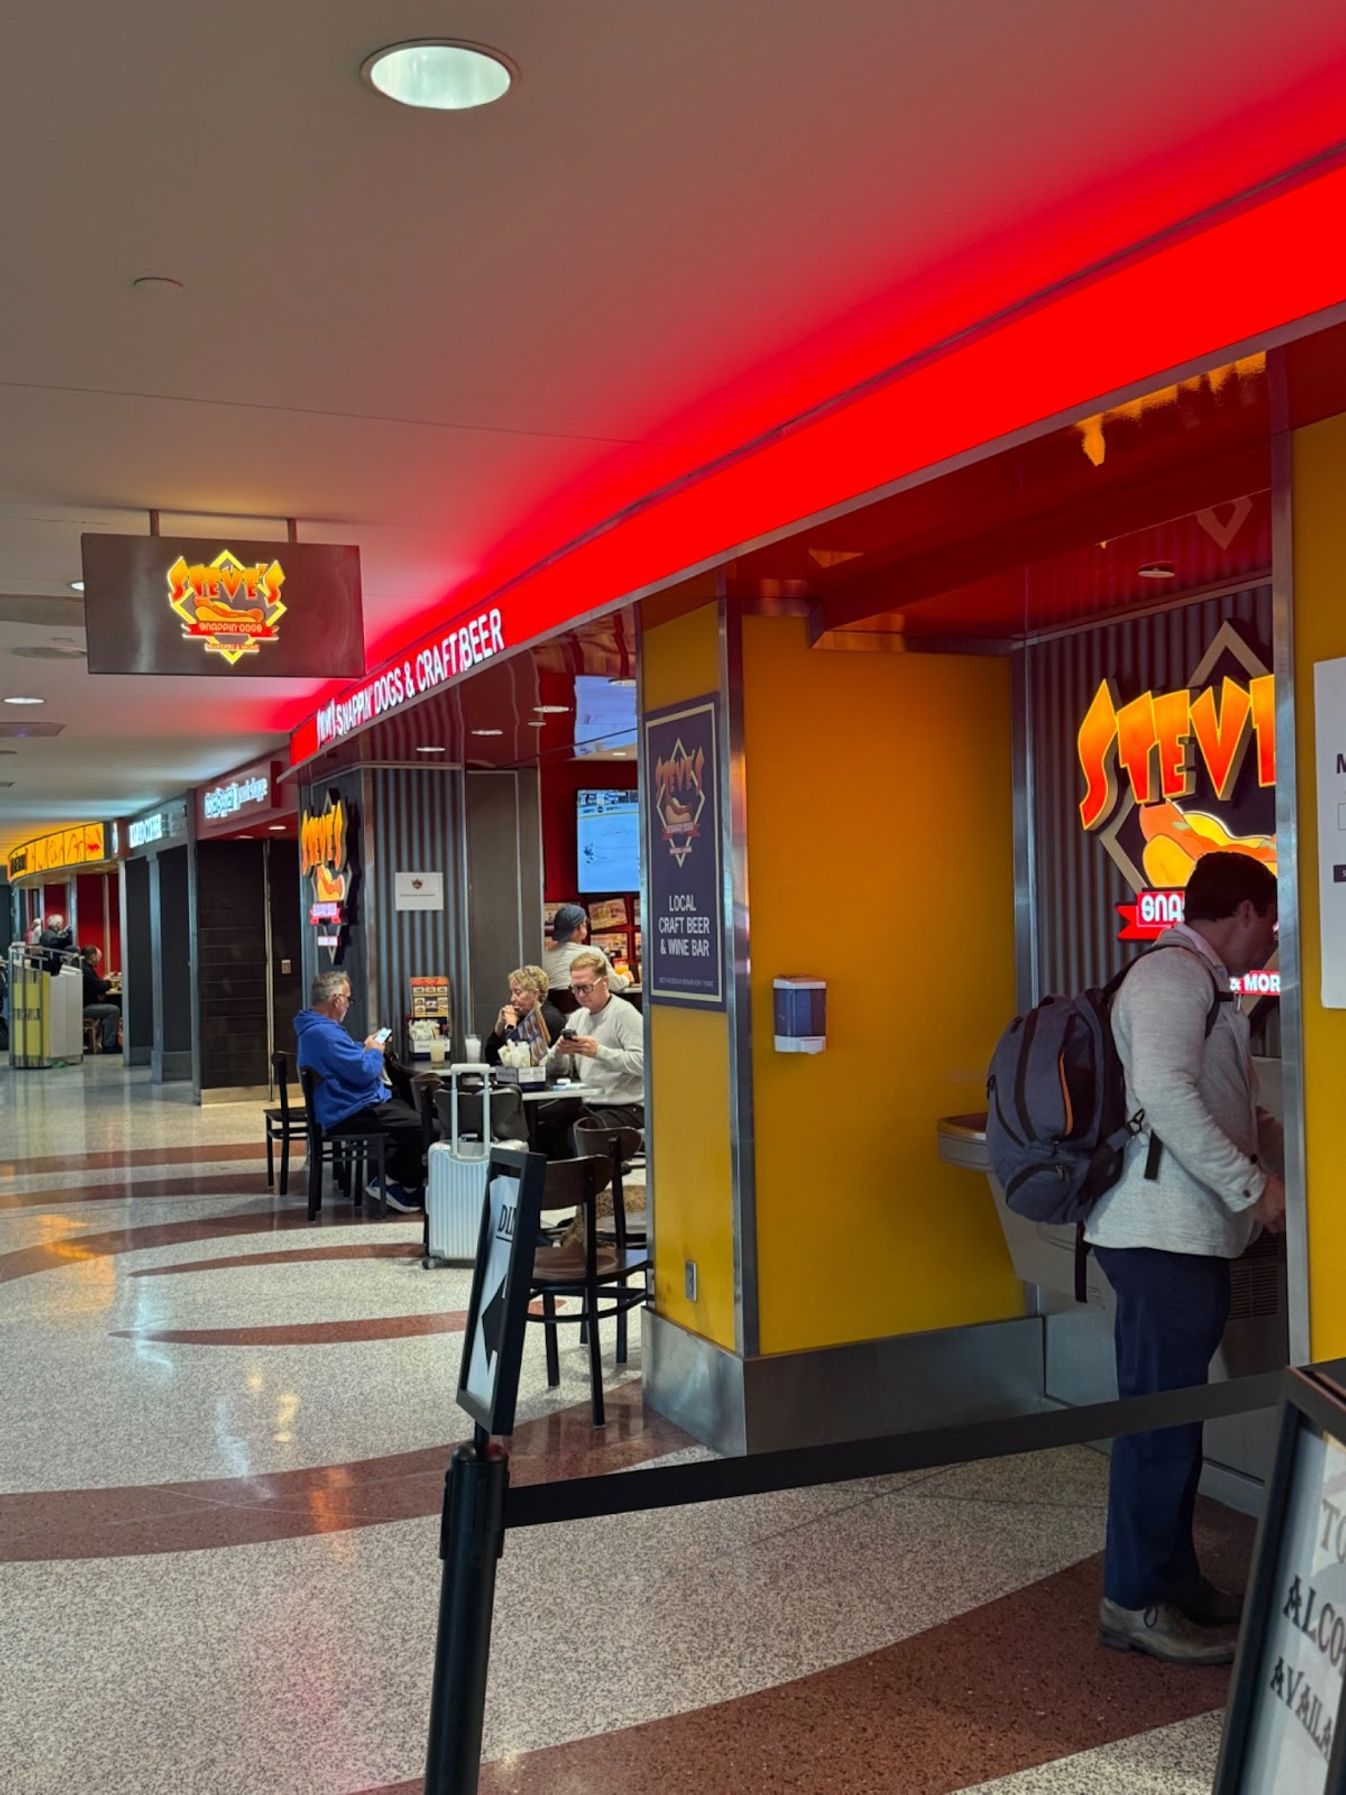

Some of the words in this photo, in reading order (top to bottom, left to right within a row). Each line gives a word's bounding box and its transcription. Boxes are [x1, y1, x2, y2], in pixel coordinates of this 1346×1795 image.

[167, 556, 285, 608] STEVE'S
[374, 667, 404, 715] DOGS
[404, 661, 415, 698] &
[415, 633, 458, 692] CRAFT
[458, 608, 505, 671] BEER
[669, 894, 697, 912] LOCAL
[1141, 894, 1184, 922] SNA
[658, 917, 684, 934] CRAFT
[686, 917, 710, 934] BEER
[660, 938, 667, 955] &
[668, 938, 689, 956] WINE
[691, 939, 710, 957] BAR
